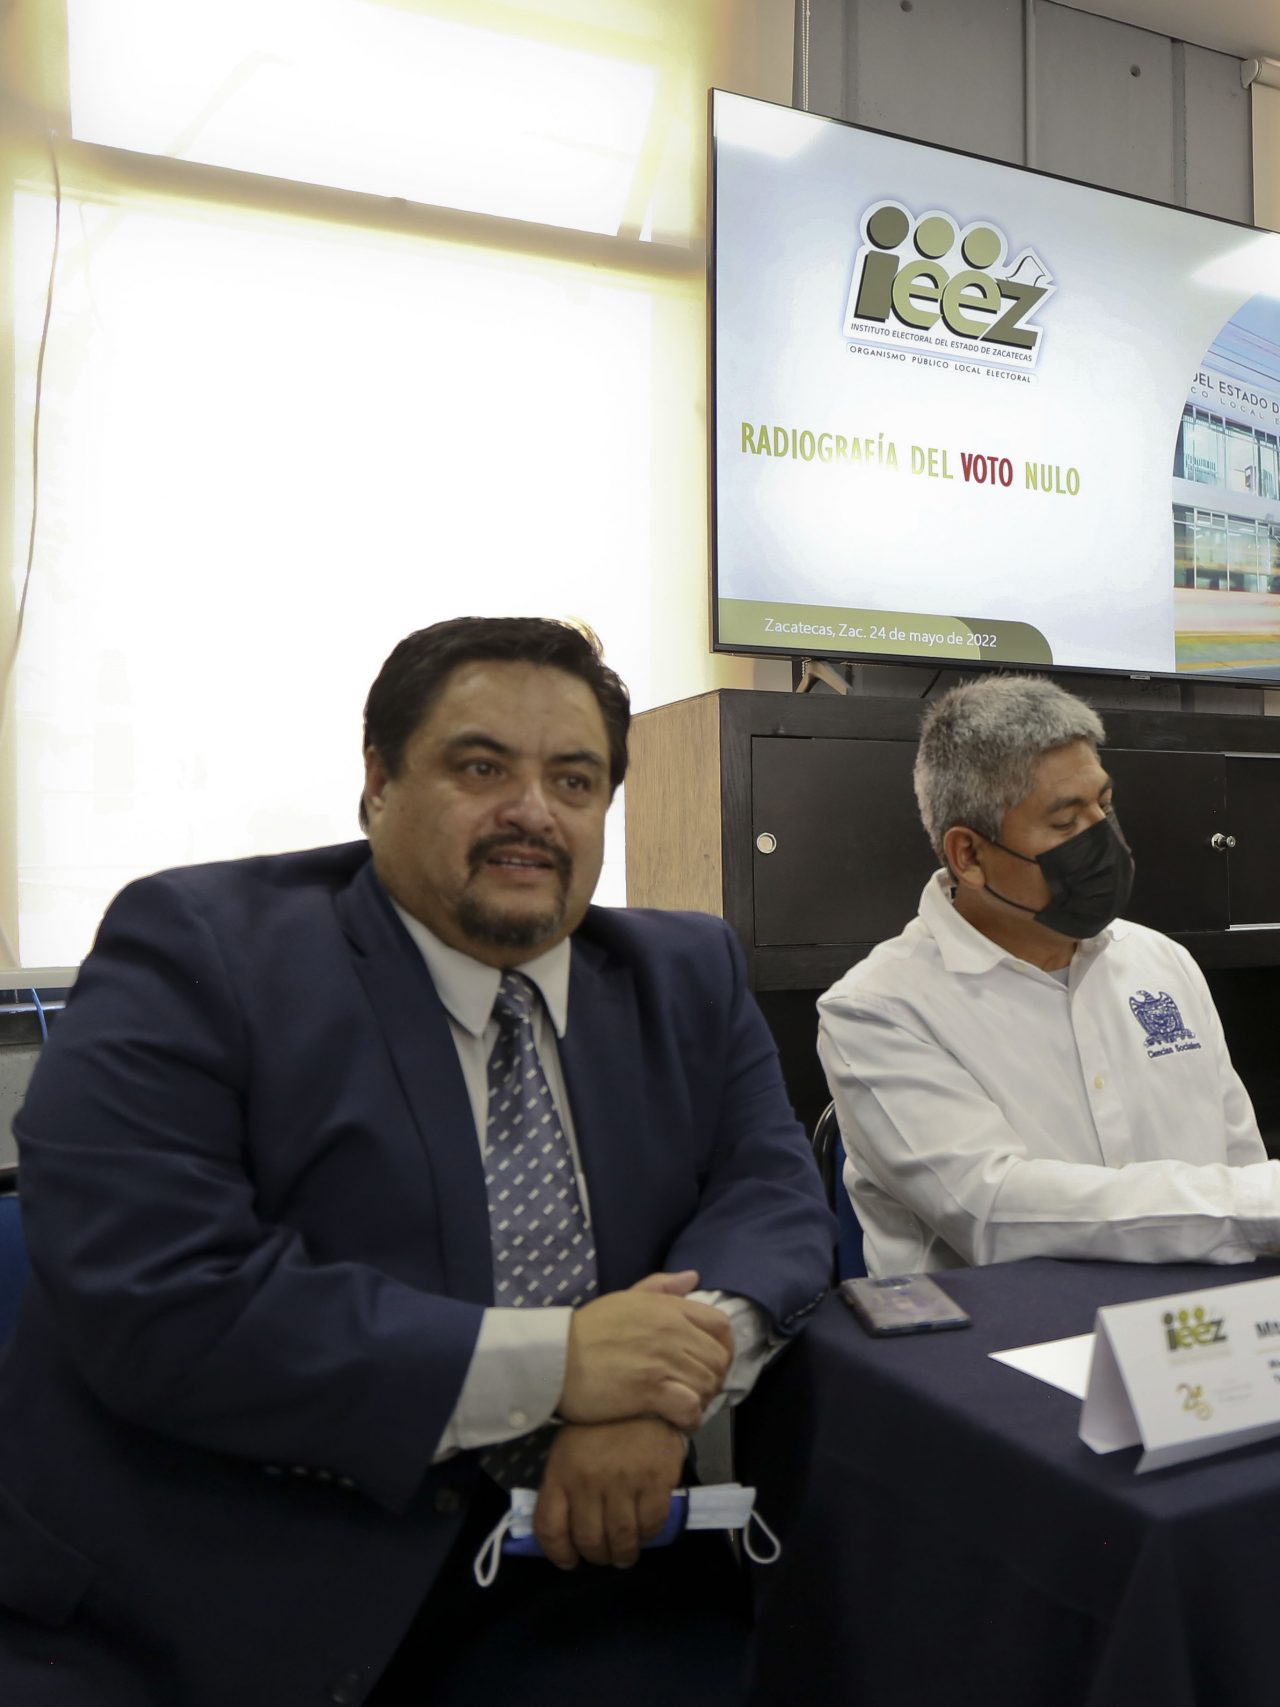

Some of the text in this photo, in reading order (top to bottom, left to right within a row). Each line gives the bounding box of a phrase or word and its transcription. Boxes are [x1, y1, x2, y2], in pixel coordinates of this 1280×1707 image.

[852, 206, 1048, 350] ieez
[851, 323, 1033, 362] INSTITUTO ELECTORAL DEL ESTADO DE ZACATECAS
[849, 345, 1031, 384] ORGANISMO PÚBLICO LOCAL ELECTORAL
[1219, 381, 1268, 409] ESTADO
[1220, 399, 1264, 419] LOCAL
[741, 422, 1080, 496] RADIOGRAFÍA DEL VOTO NULO
[764, 618, 997, 648] Zacatecas, Zac. 24 de mayo de 2022
